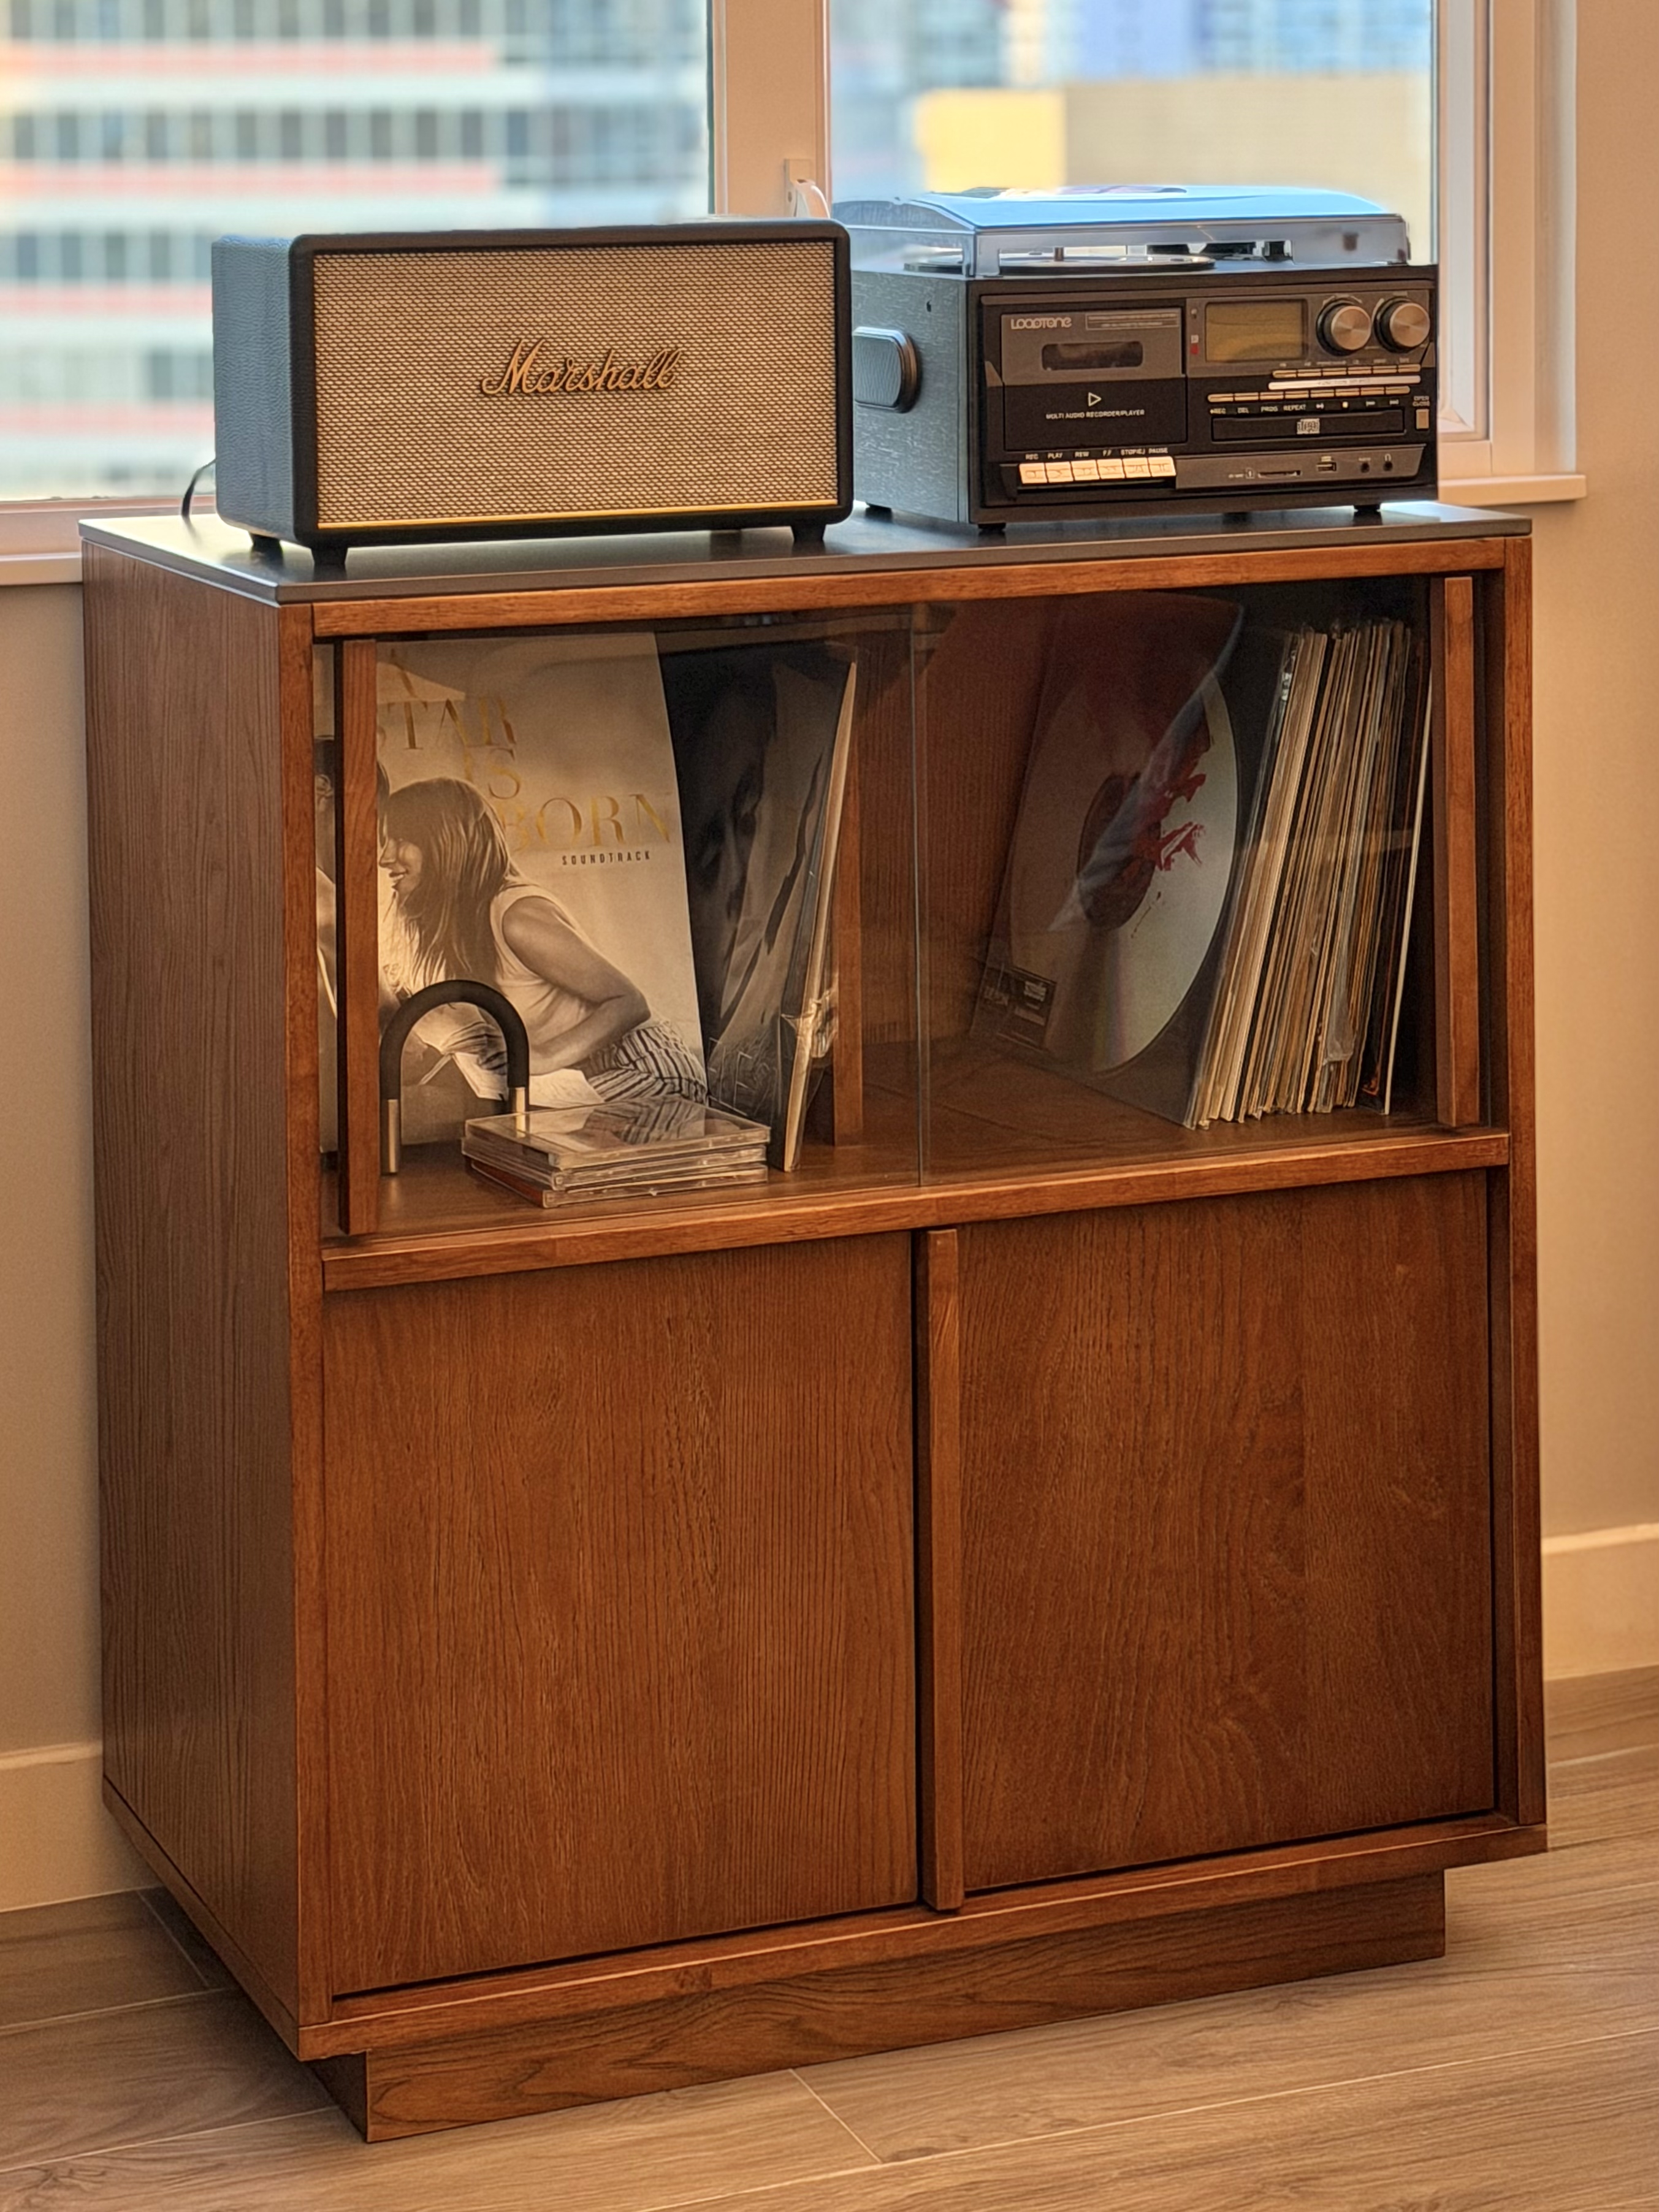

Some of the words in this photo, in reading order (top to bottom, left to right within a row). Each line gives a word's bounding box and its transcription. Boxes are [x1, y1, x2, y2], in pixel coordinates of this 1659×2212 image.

[481, 338, 683, 394] Marshall
[494, 793, 673, 853] BORN
[562, 850, 651, 866] SOUNDTRACK
